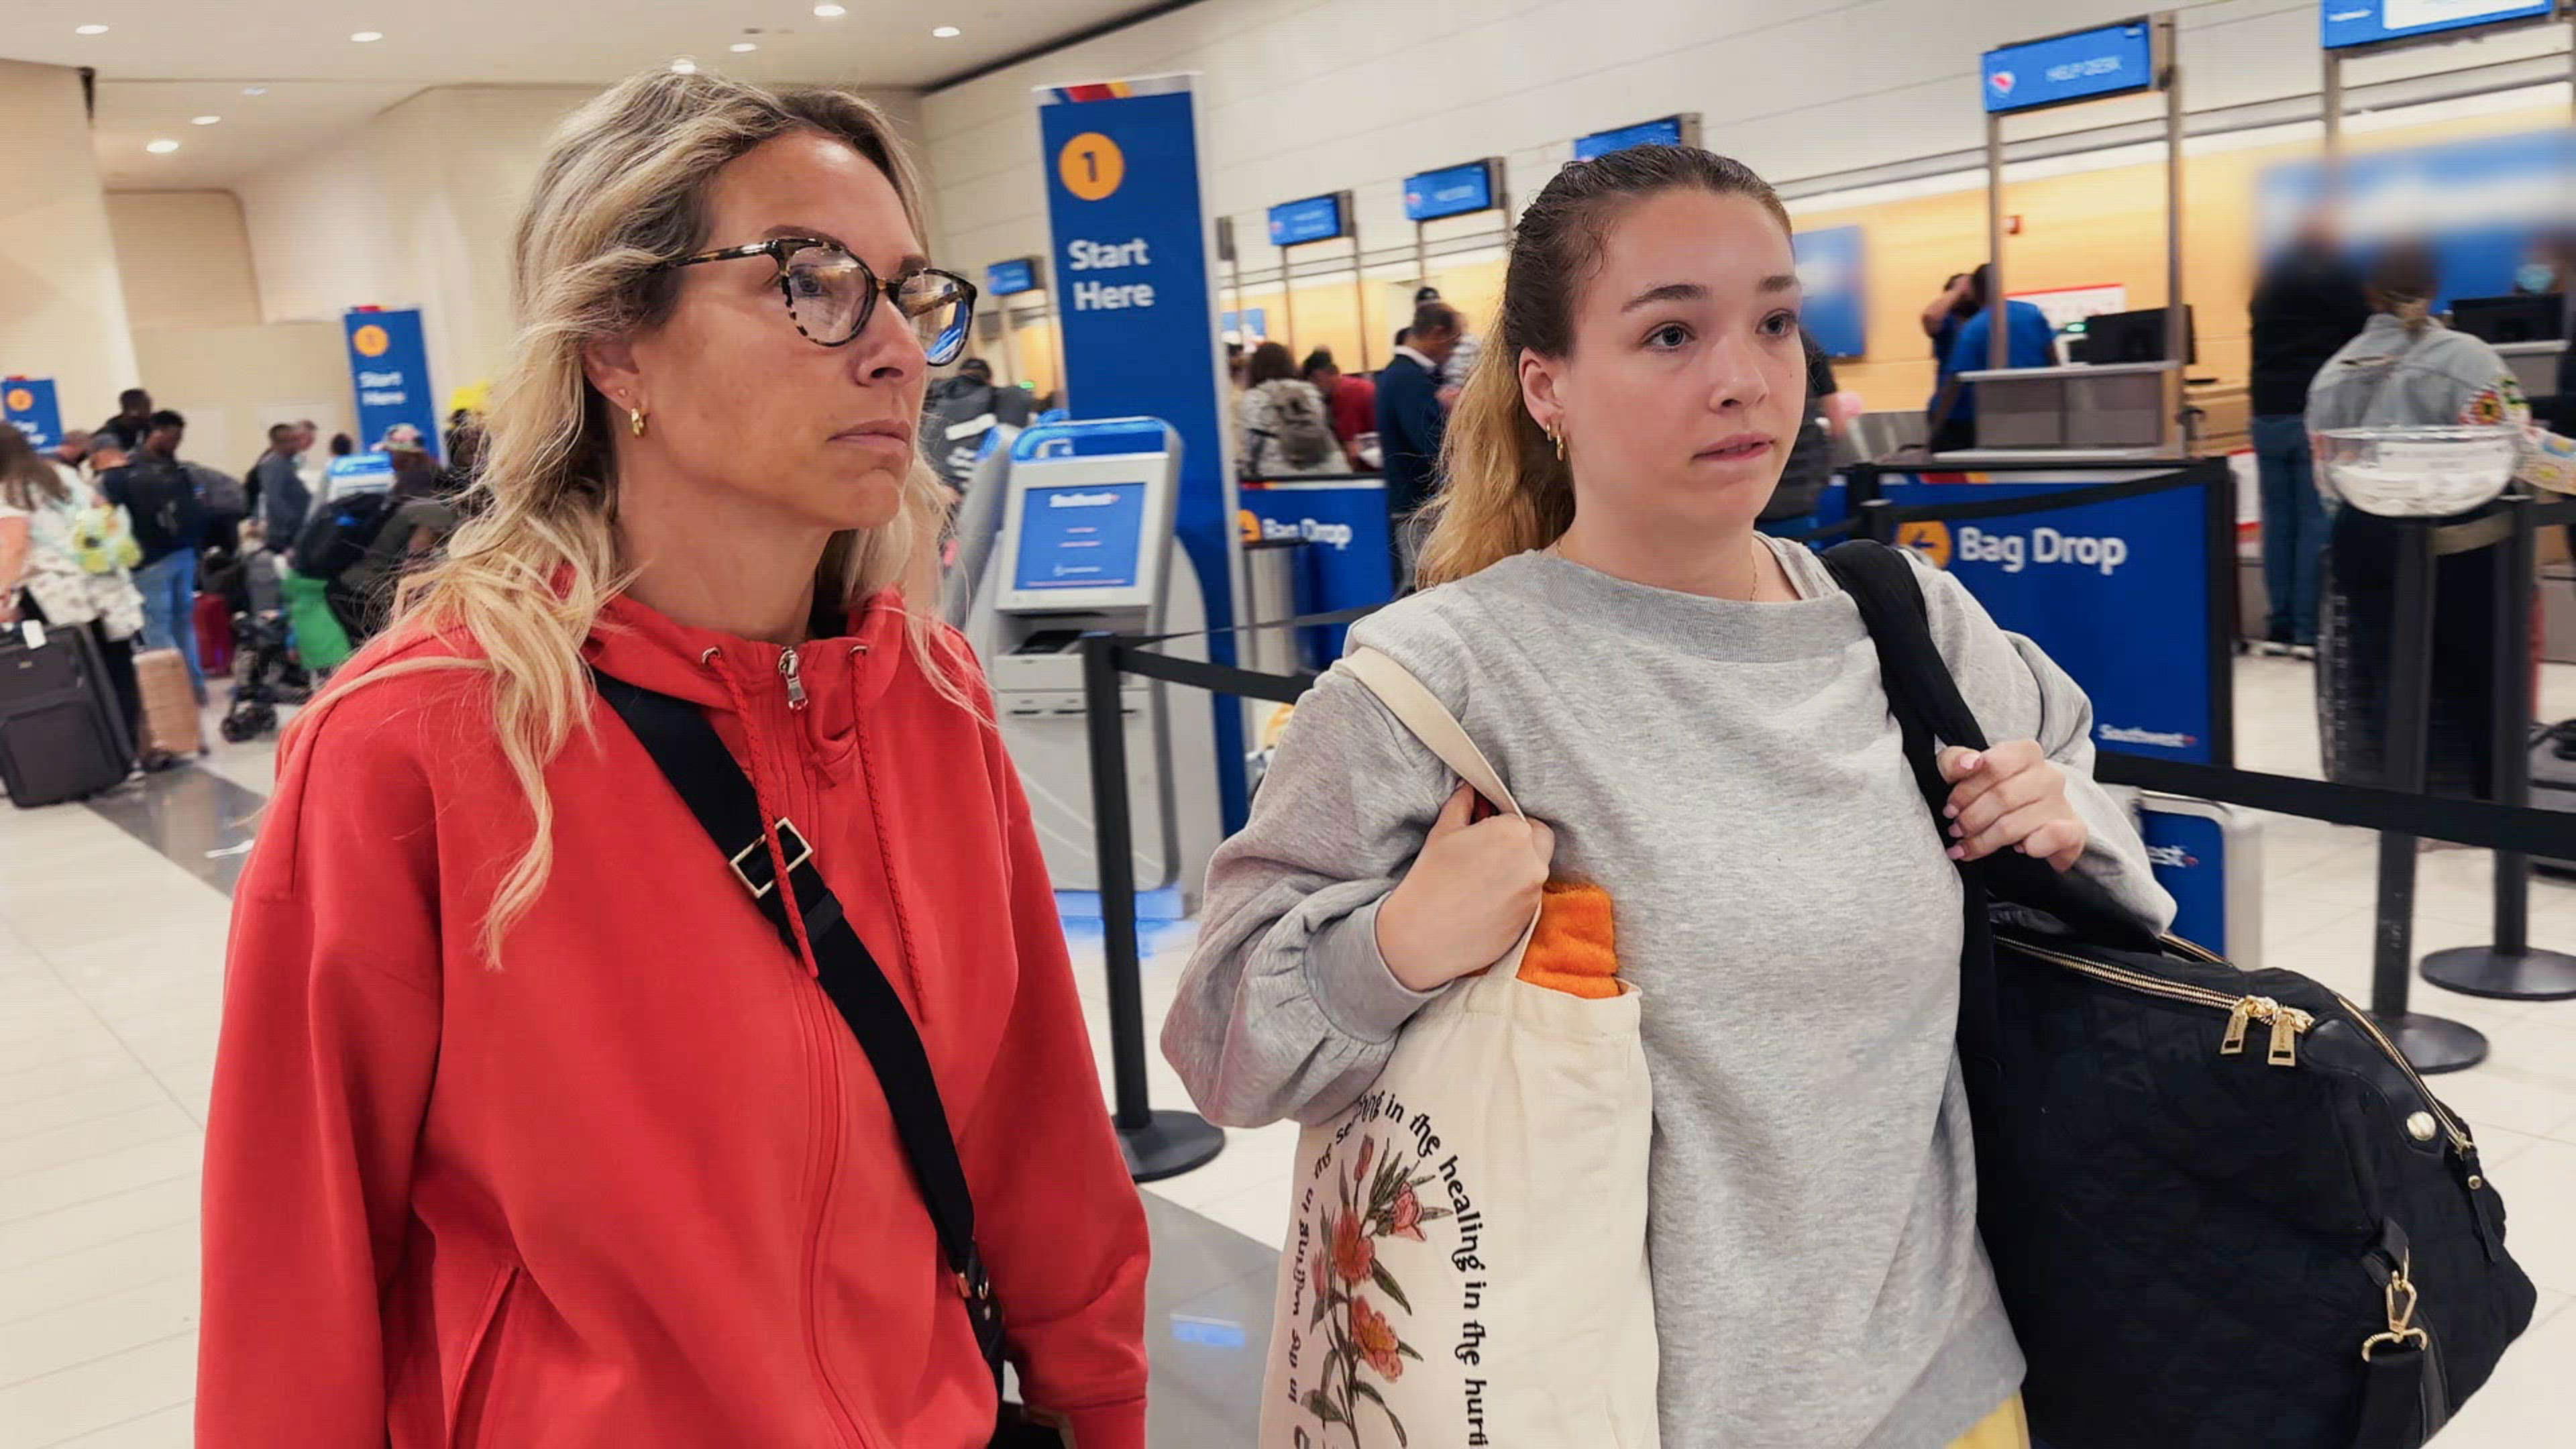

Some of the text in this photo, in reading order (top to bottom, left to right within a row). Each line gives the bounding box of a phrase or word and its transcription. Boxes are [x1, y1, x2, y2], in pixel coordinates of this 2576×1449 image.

[1081, 151, 1098, 182] 1
[1067, 237, 1150, 270] Start
[1073, 280, 1155, 311] Here
[1300, 518, 1352, 550] Drop
[1958, 526, 2128, 575] Bag Drop
[1385, 1093, 1404, 1123] in
[1409, 1114, 1440, 1157] the
[1301, 1187, 1313, 1214] in
[1439, 1154, 1486, 1272] healing
[1464, 1281, 1487, 1309] in
[1454, 1320, 1487, 1366] the
[1465, 1379, 1489, 1446] hurti
